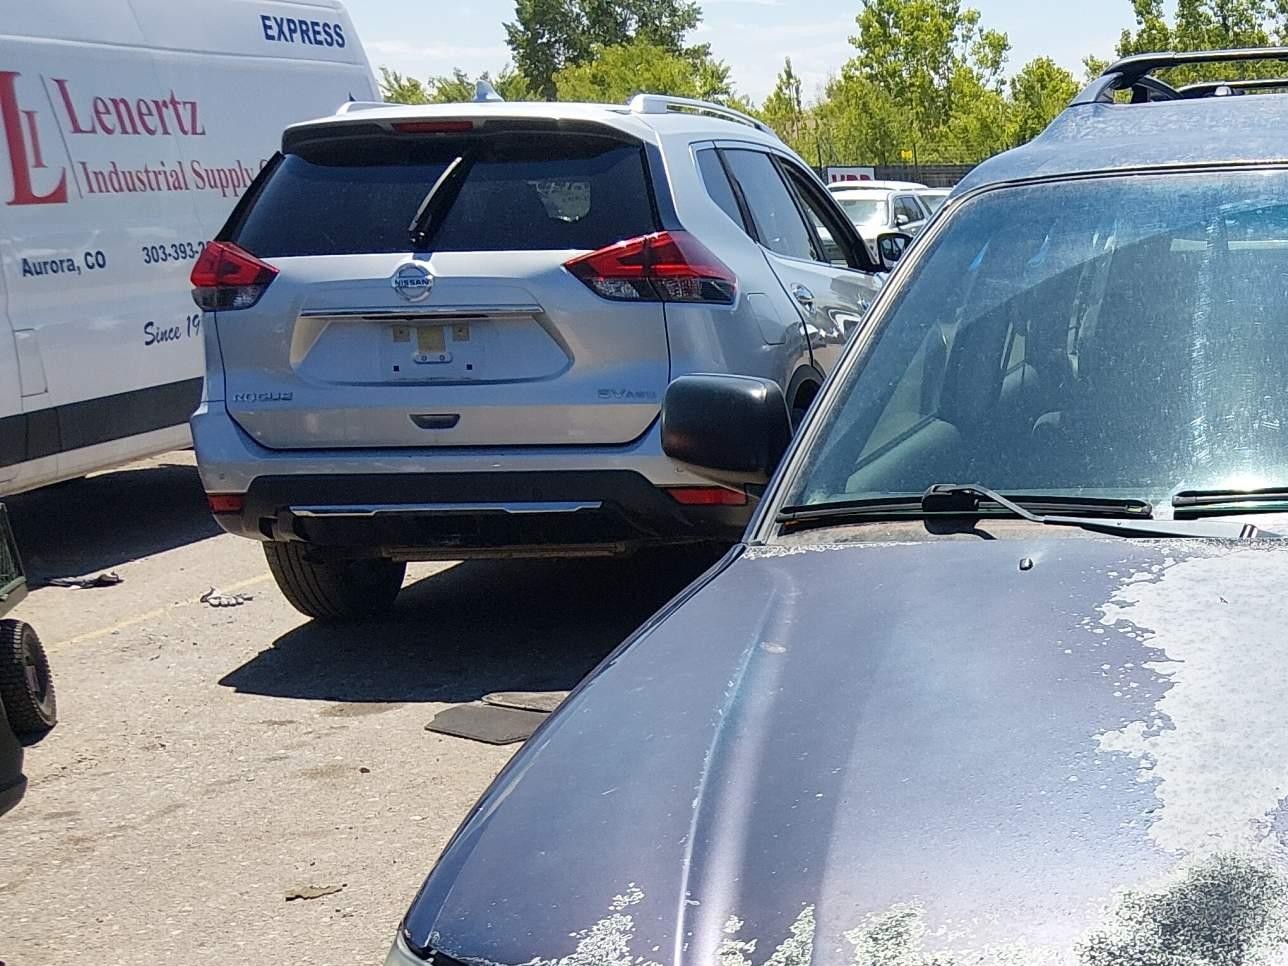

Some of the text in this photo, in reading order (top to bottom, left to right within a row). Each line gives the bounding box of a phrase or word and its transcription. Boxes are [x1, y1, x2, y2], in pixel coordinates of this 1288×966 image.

[260, 15, 345, 48] EXPRESS
[50, 76, 206, 137] Lenertz
[79, 160, 190, 195] Industrial
[22, 250, 107, 277] Aurora, CO
[393, 278, 432, 288] NISSAN
[143, 320, 182, 346] Since
